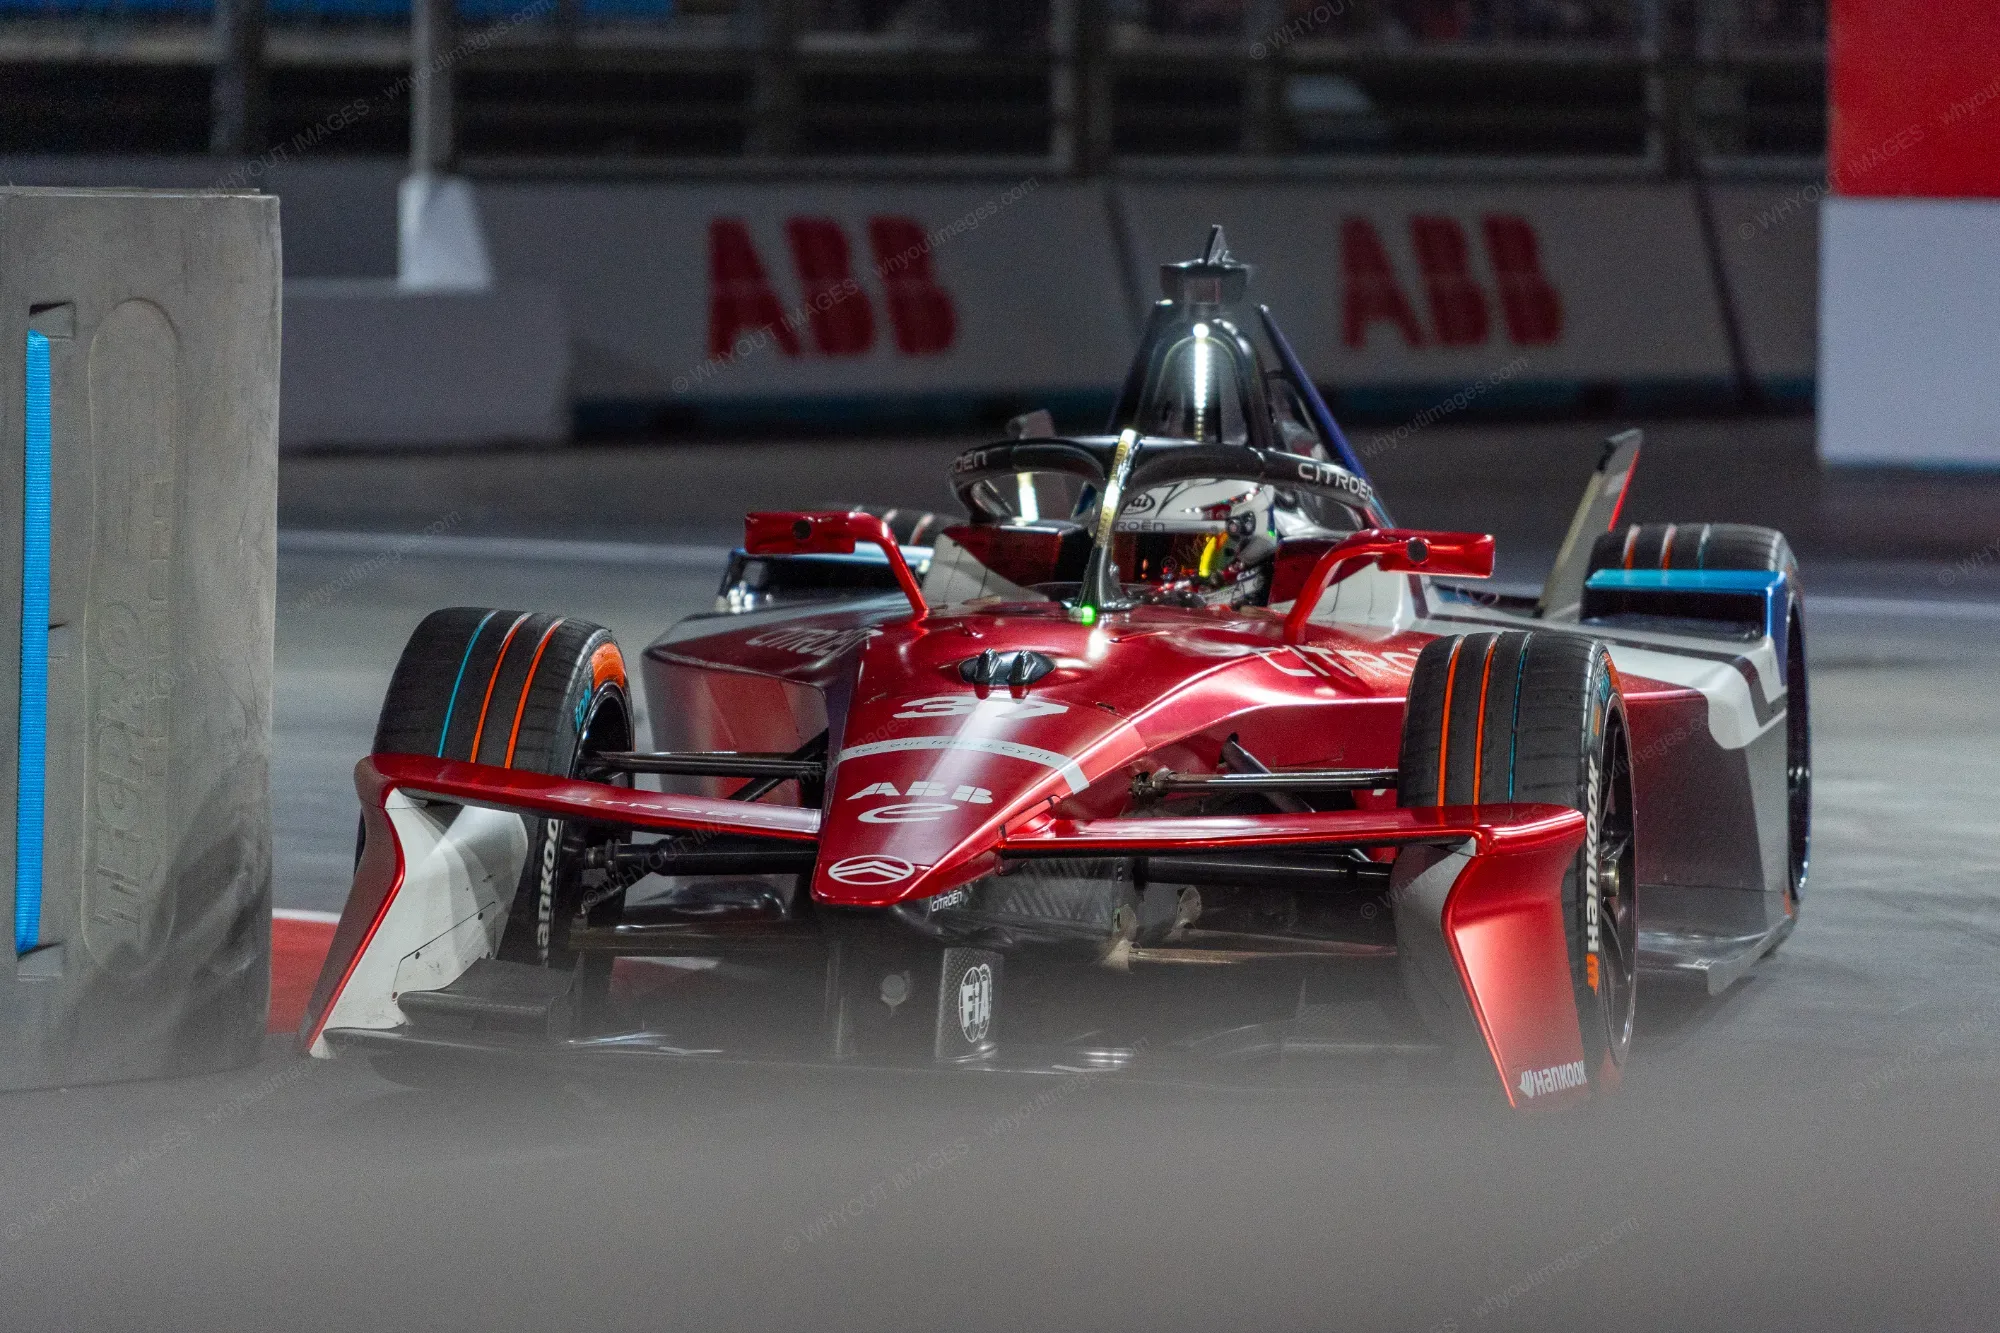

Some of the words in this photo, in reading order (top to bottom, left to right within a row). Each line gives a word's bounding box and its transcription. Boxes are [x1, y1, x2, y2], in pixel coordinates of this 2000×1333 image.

[707, 214, 958, 359] ABB
[1341, 213, 1564, 349] ABB
[1252, 644, 1422, 677] CITRO
[892, 695, 1069, 721] 37
[846, 781, 993, 804] ABB
